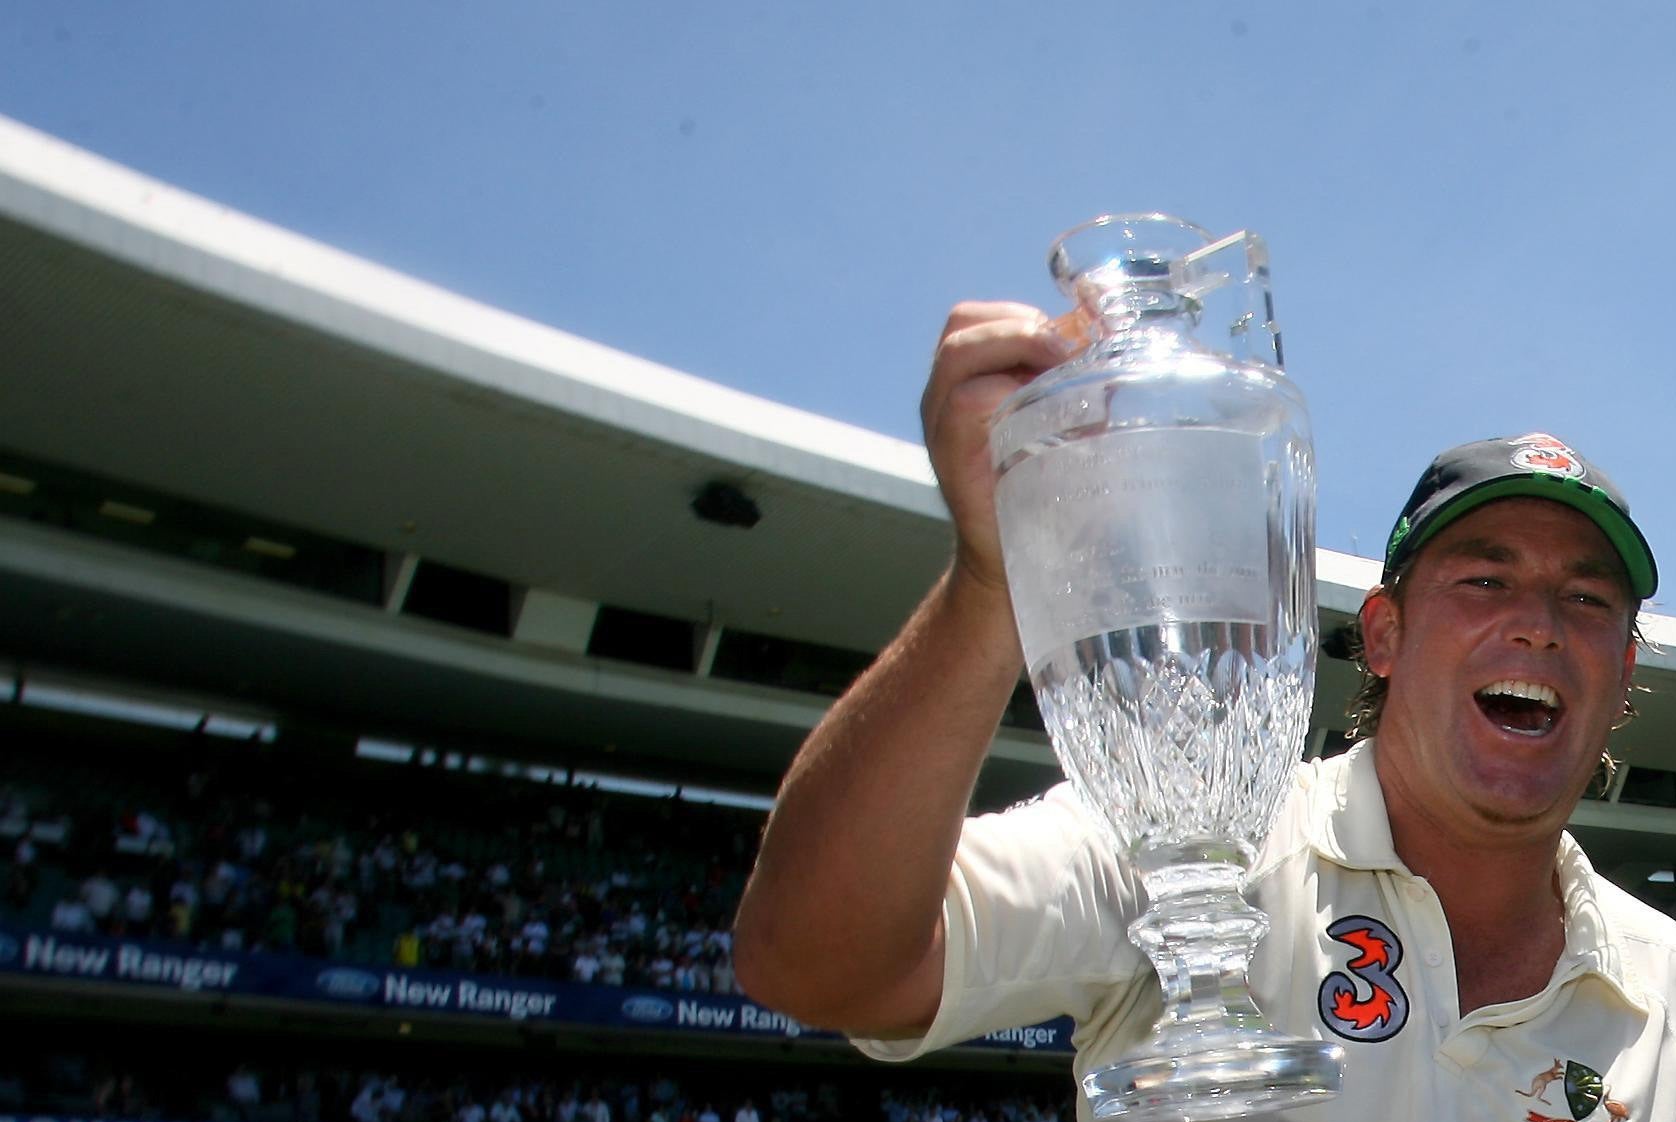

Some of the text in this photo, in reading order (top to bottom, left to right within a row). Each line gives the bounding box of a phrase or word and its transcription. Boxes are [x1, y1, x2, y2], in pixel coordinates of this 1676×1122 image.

[25, 935, 238, 991] New Ranger
[1317, 914, 1410, 1043] 3
[384, 974, 451, 1006] New
[457, 982, 556, 1019] Ranger
[677, 1000, 735, 1027] New
[740, 1003, 814, 1038] Rang
